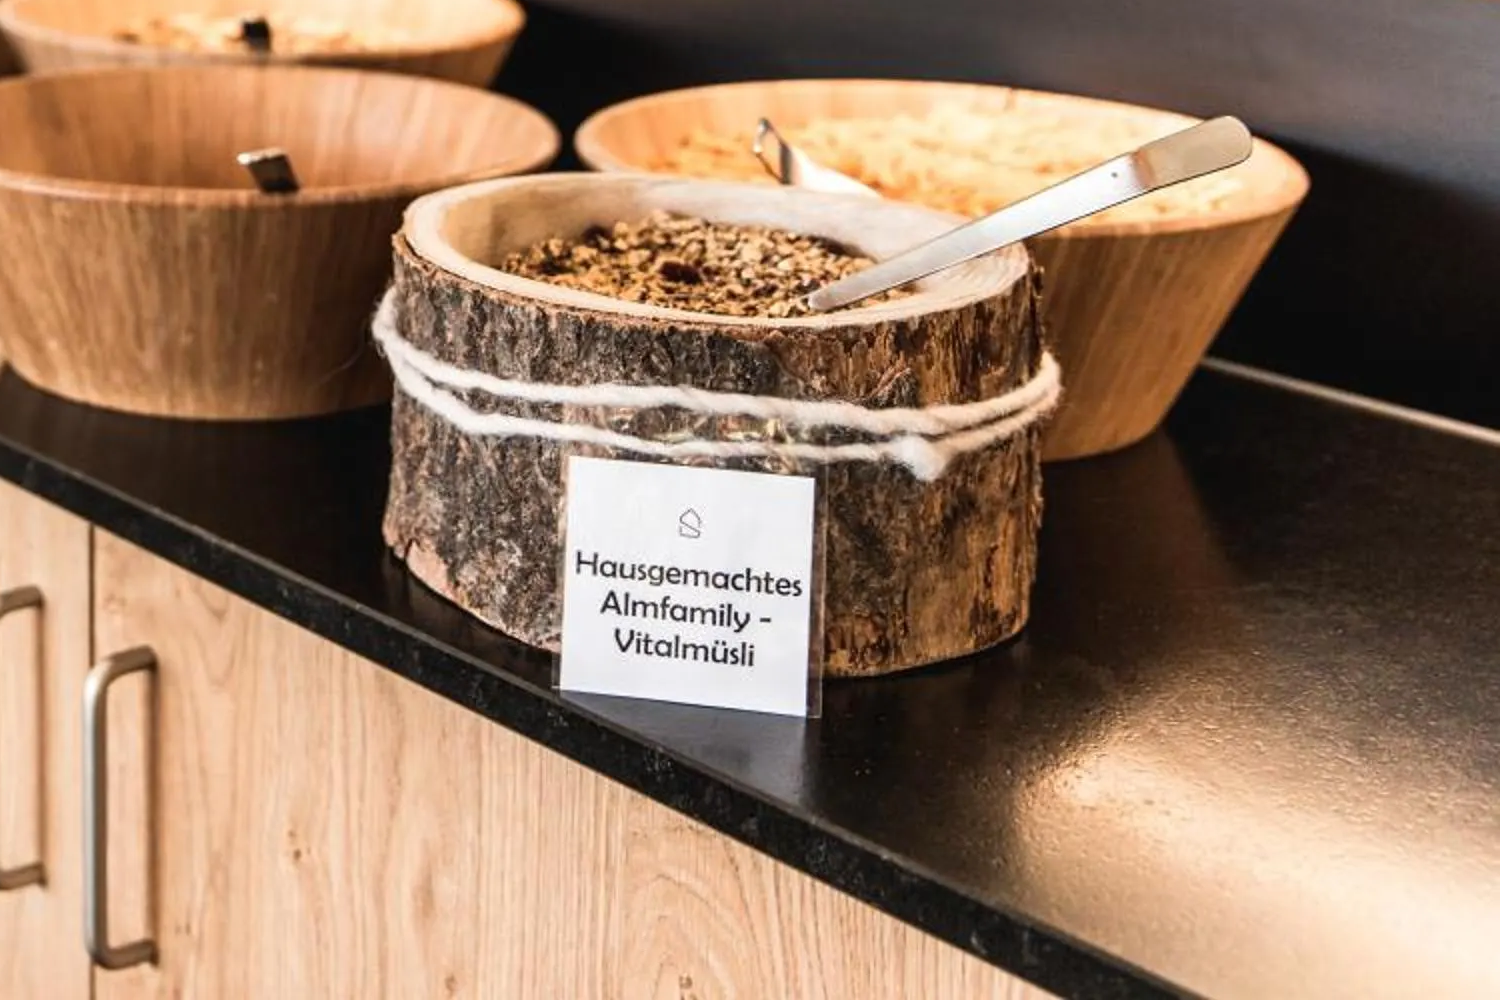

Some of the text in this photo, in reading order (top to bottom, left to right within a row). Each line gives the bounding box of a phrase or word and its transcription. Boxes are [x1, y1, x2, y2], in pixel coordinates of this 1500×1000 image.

[575, 550, 802, 597] Hausgemachtes
[600, 590, 750, 633] Almfamily
[614, 629, 755, 667] Vitalmüsli
